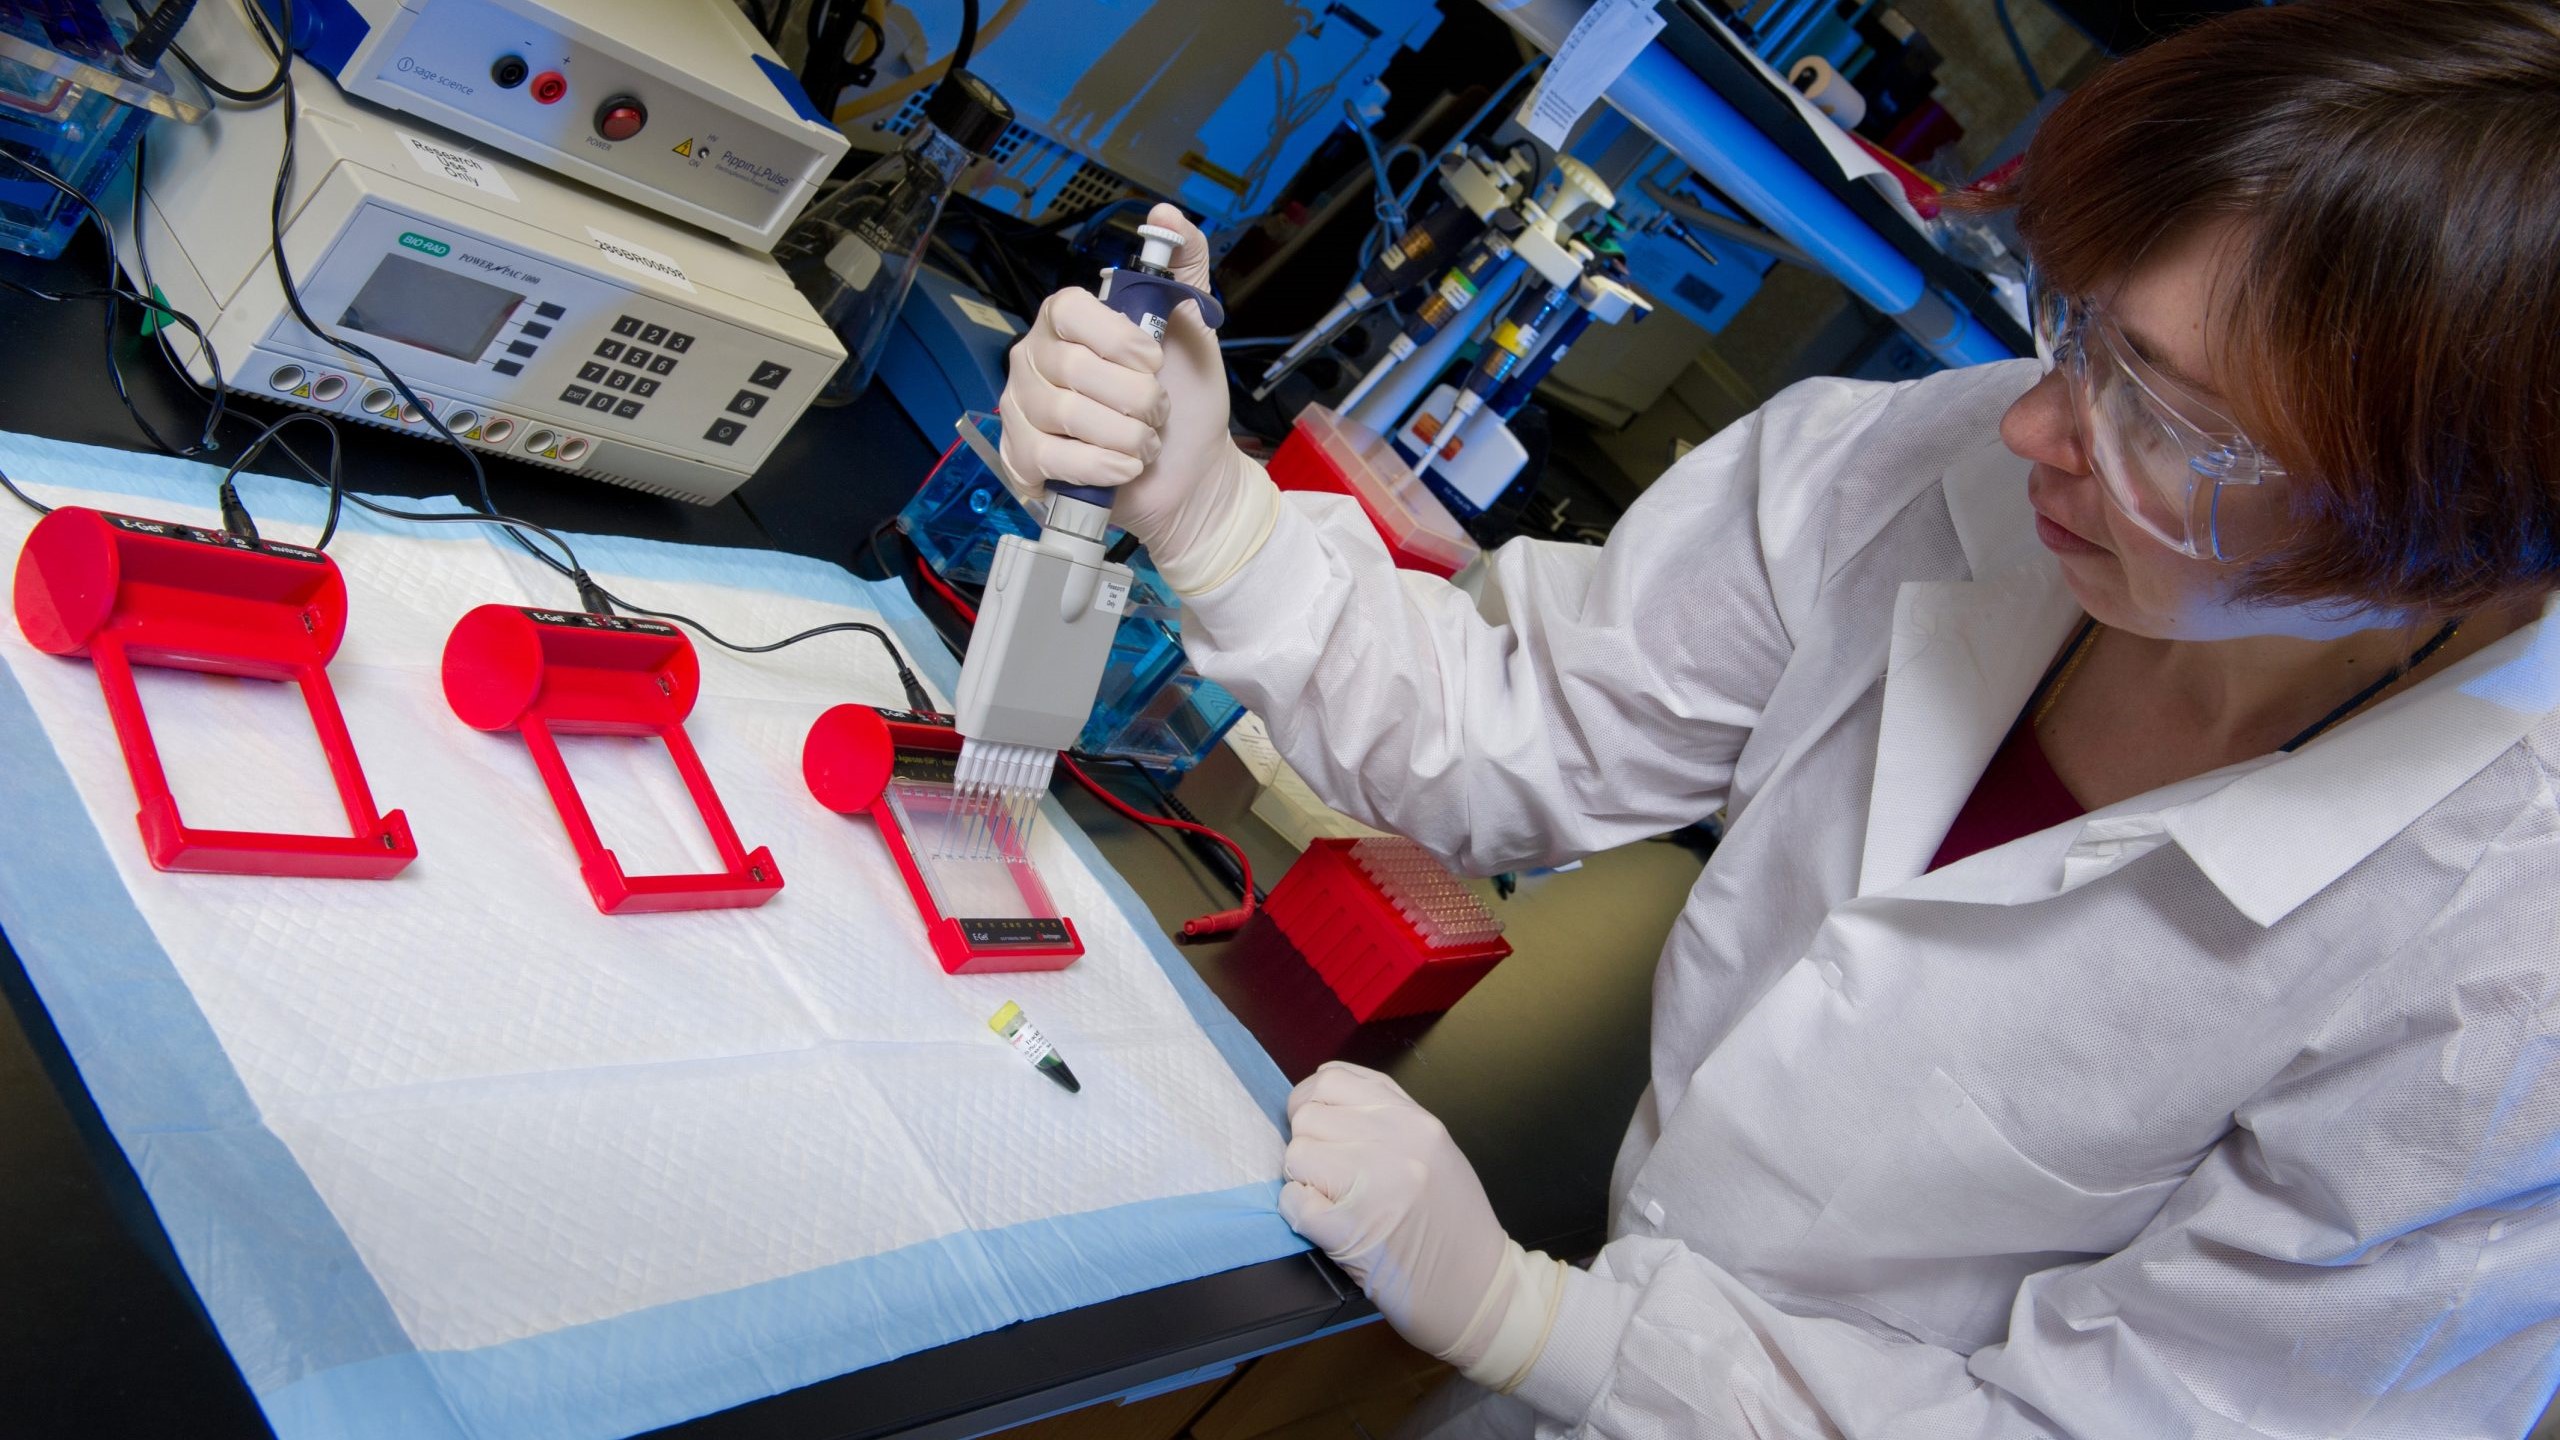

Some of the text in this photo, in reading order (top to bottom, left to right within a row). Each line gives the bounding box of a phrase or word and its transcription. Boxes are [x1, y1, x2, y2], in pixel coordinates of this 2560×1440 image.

[413, 65, 474, 96] sage science
[411, 139, 482, 171] Research
[585, 136, 612, 152] POWER
[436, 156, 468, 173] Use
[688, 159, 701, 168] ON
[721, 150, 789, 187] Pippin Pulse
[444, 166, 479, 187] Only
[459, 253, 541, 285] POWER PAC 1000
[595, 239, 686, 280] 286BR00698
[624, 321, 685, 348] 1 2 3
[605, 344, 668, 371] 4 5 6
[588, 367, 651, 393] 7 8 9
[567, 390, 635, 414] EXIT 0 CE
[120, 519, 164, 534] E-Gel
[1107, 582, 1126, 592] Research
[1106, 600, 1116, 609] Only
[532, 612, 566, 623] E-Gel
